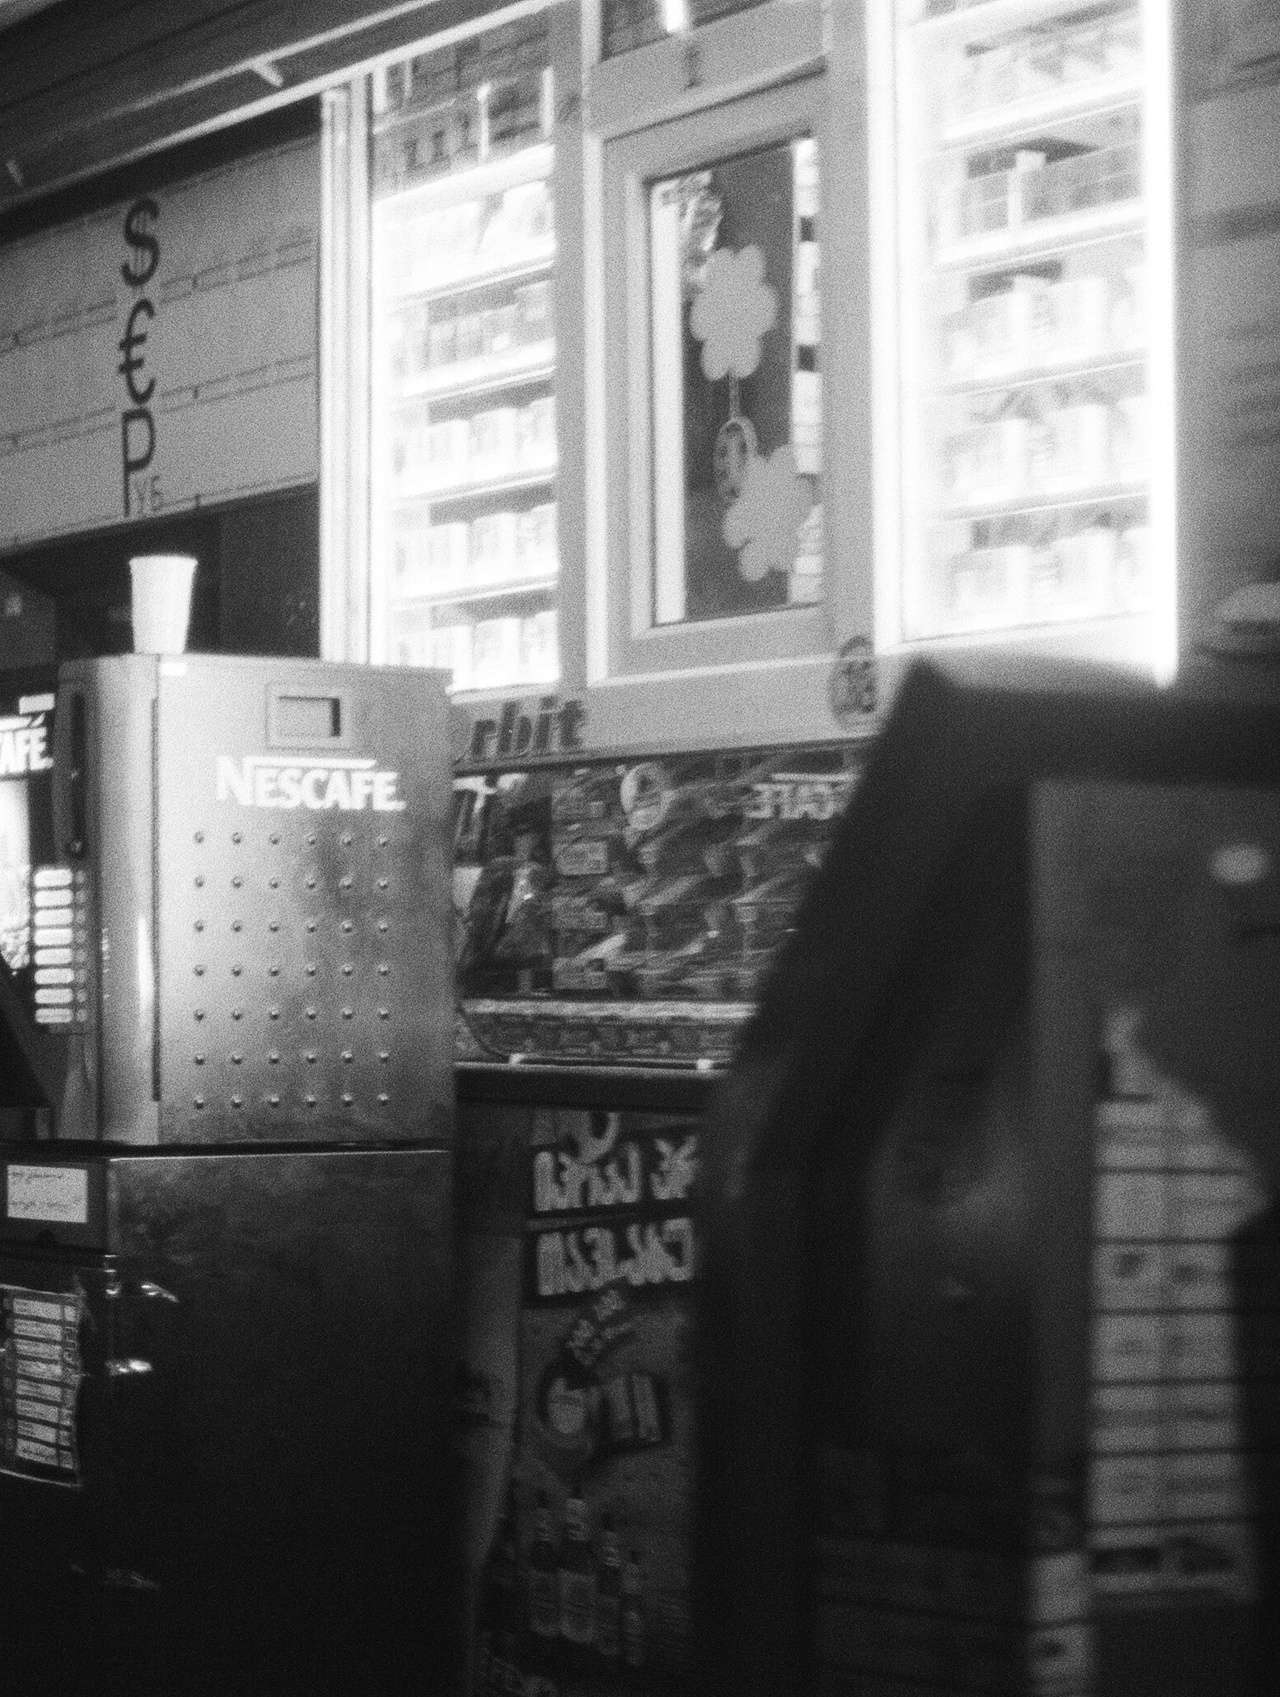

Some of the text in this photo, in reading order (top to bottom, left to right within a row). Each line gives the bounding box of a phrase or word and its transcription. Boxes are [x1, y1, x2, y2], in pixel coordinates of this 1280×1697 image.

[119, 197, 159, 290] $
[118, 298, 156, 405] €
[470, 696, 586, 763] rbit
